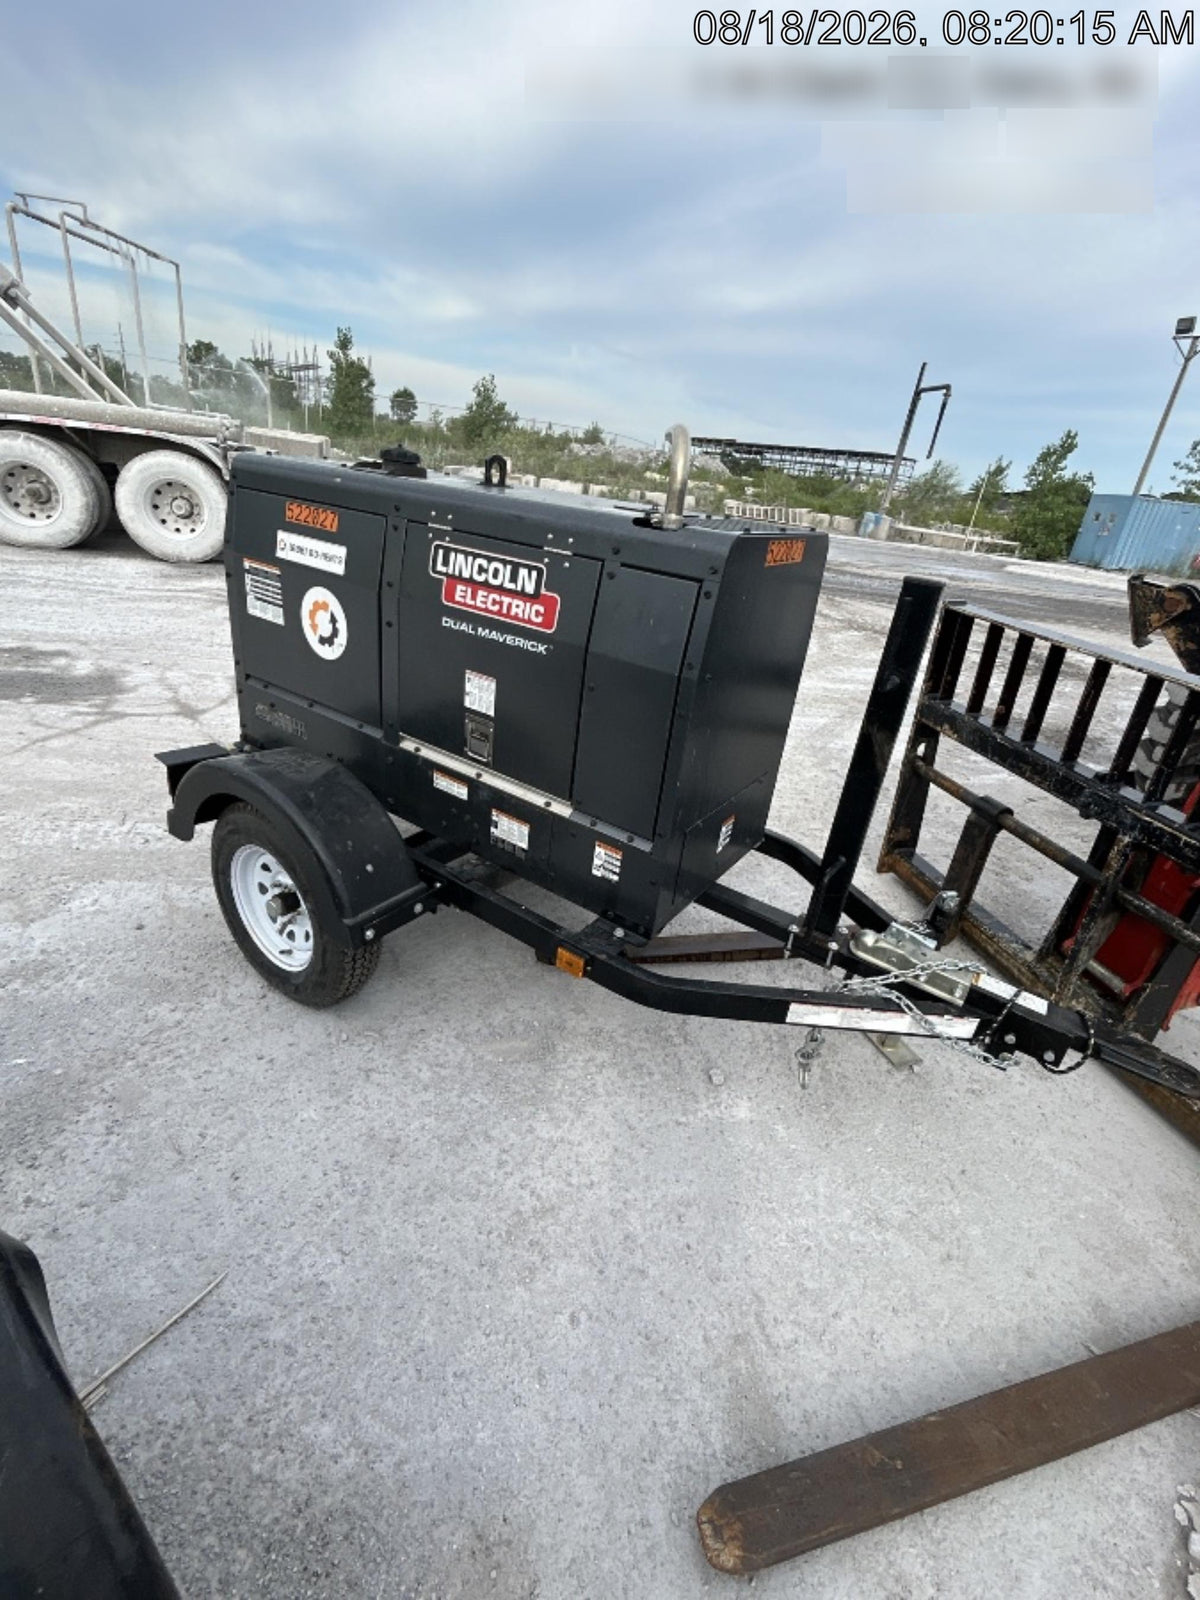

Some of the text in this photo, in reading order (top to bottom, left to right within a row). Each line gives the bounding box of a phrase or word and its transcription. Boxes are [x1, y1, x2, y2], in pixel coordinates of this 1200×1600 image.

[436, 549, 538, 595] LINCOLN
[454, 584, 545, 623] ELECTRIC
[441, 616, 549, 655] DUAL MAVERICK
